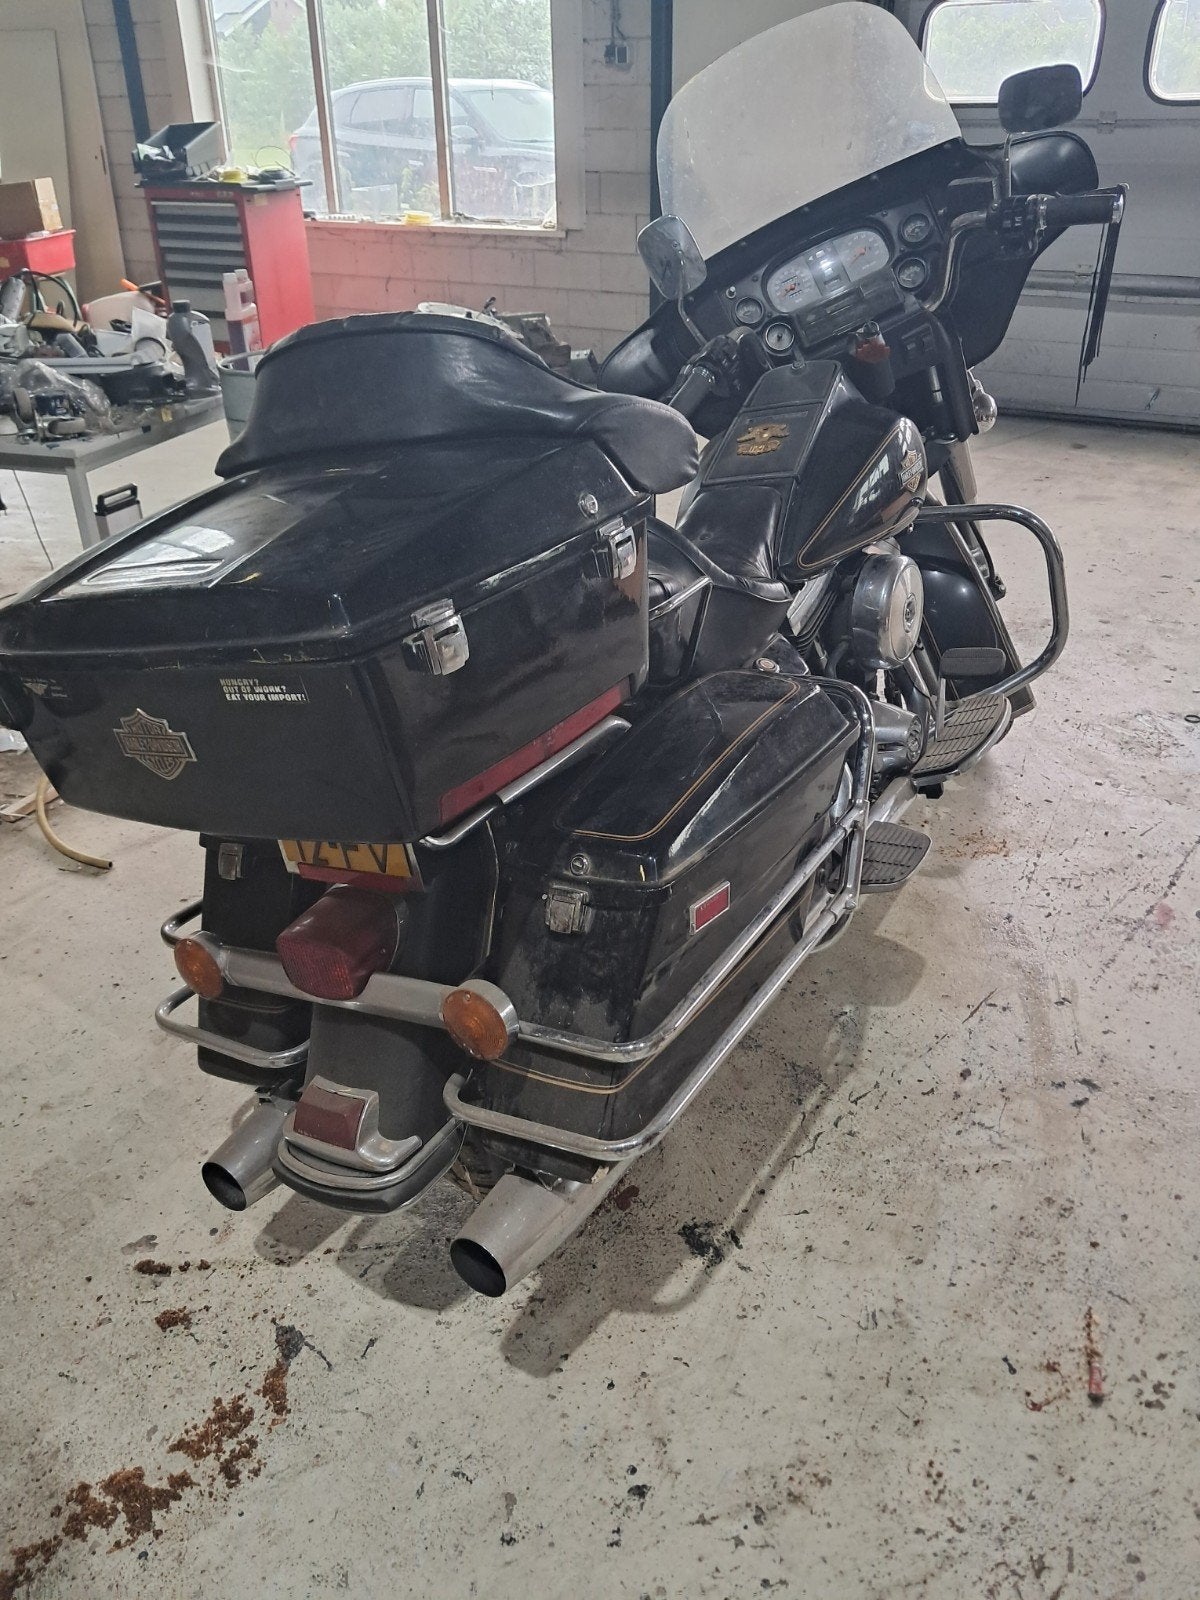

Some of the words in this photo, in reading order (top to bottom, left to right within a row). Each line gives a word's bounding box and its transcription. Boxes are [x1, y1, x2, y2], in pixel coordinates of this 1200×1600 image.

[222, 685, 239, 693] OUT
[240, 685, 252, 693] OF
[253, 685, 287, 693] WORK?
[225, 693, 241, 701] EAT
[242, 693, 267, 701] YOUR
[267, 693, 307, 702] IMPORT!
